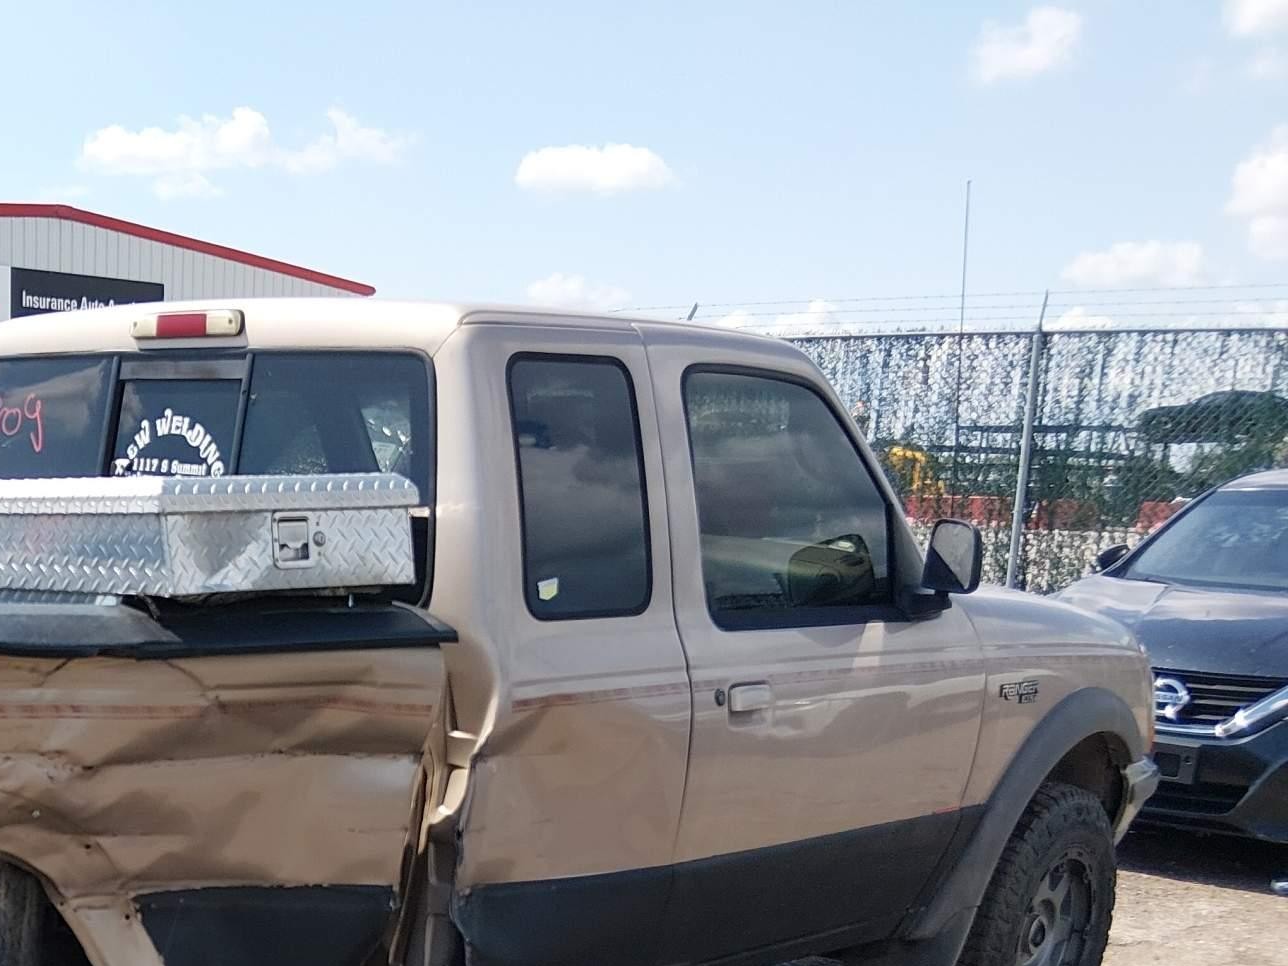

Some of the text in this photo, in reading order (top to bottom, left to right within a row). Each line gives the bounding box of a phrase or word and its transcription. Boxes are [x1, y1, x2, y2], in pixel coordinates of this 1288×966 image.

[21, 289, 78, 312] Insurance
[155, 407, 225, 479] WELDING
[132, 457, 160, 472] 1117
[170, 460, 208, 476] Summit
